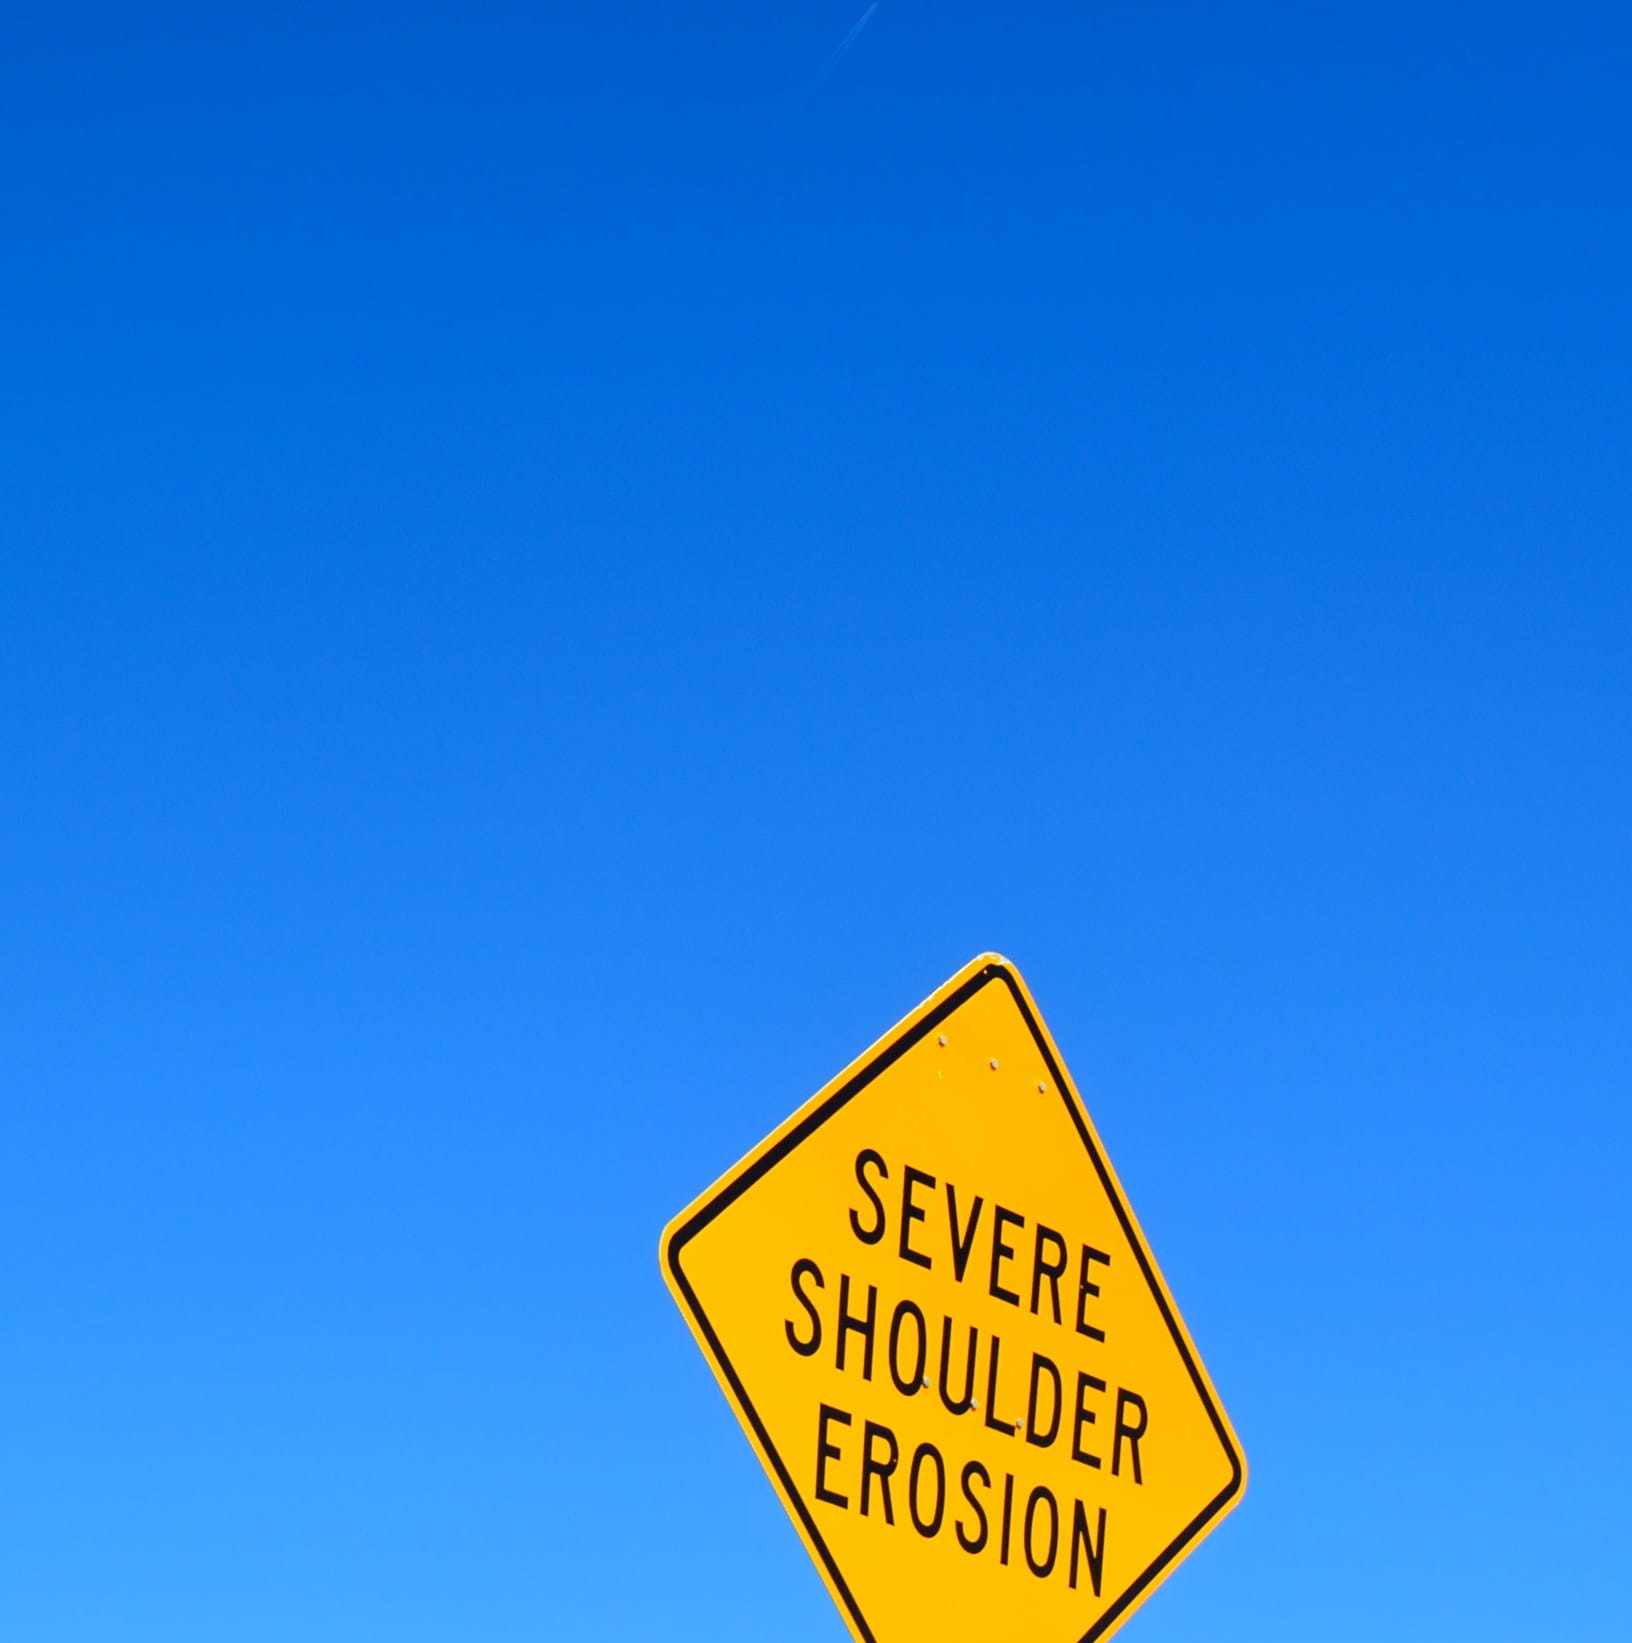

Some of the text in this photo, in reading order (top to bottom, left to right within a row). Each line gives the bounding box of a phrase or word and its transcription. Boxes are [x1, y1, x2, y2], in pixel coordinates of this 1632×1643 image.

[849, 1149, 1111, 1343] SEVERE
[784, 1258, 1148, 1485] SHOULDER
[814, 1402, 1107, 1598] EROSION
